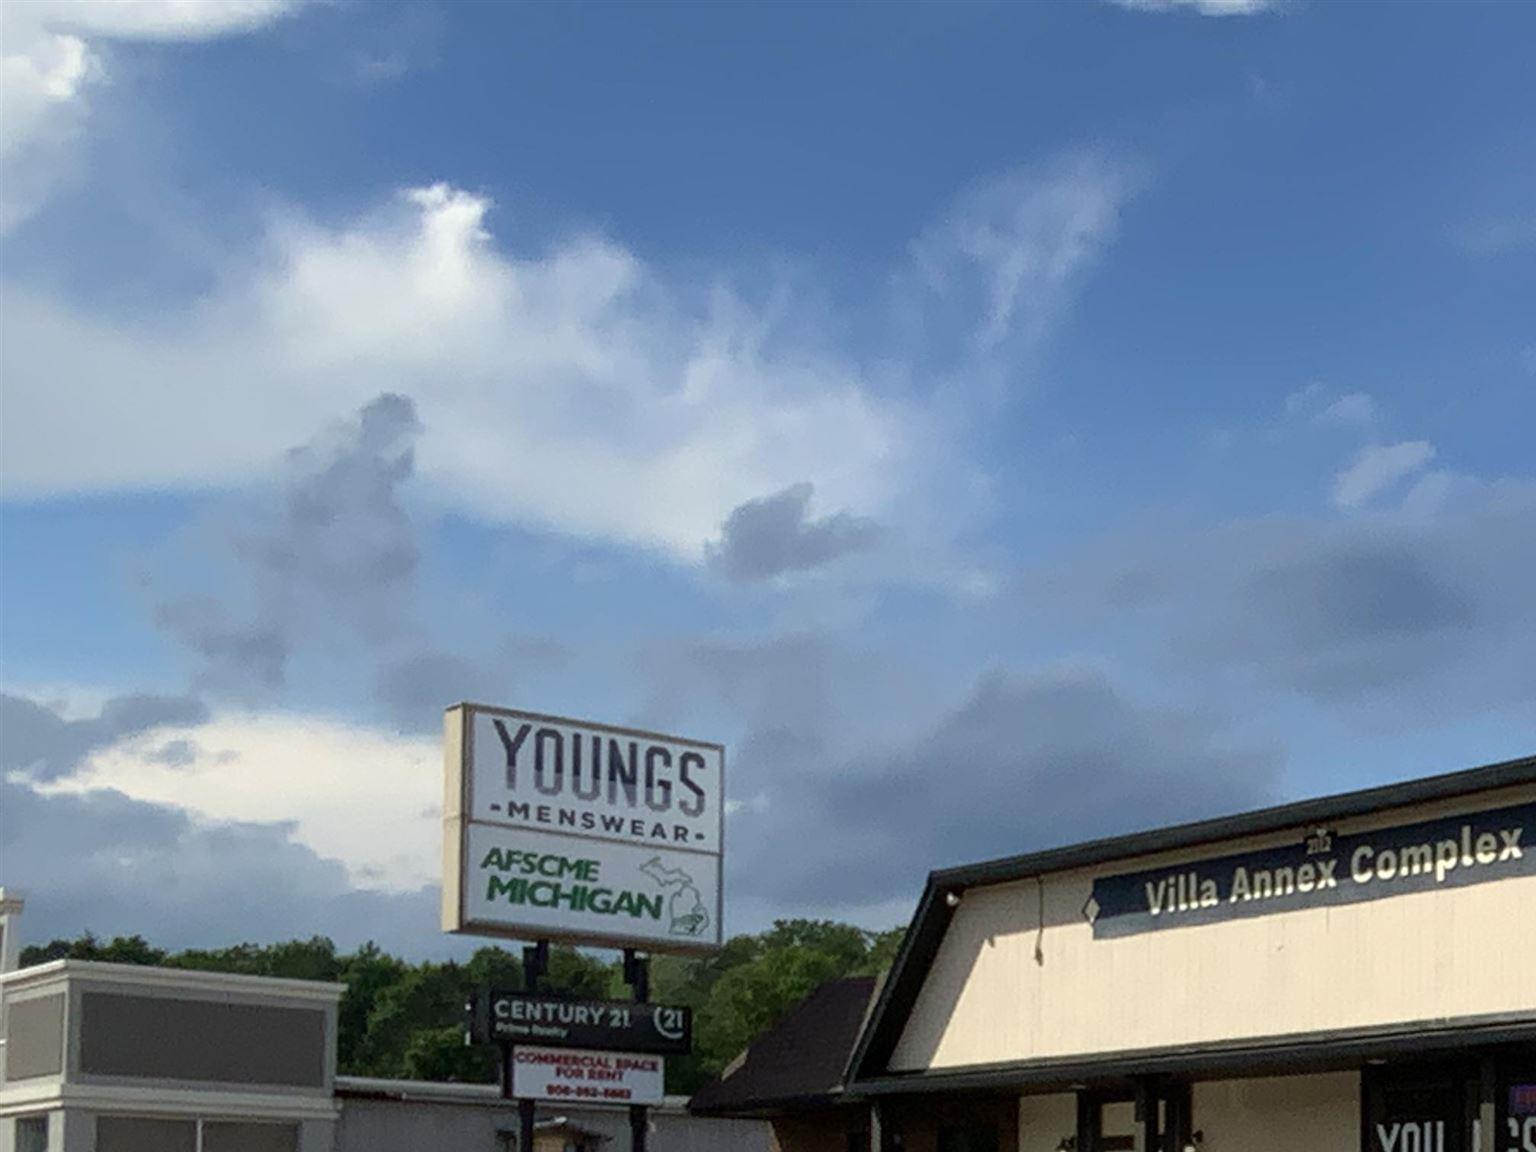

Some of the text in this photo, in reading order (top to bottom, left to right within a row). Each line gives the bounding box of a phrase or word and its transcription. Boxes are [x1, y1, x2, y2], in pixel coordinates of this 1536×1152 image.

[492, 718, 706, 818] YOUNGS
[480, 847, 601, 882] AFSCME
[1145, 825, 1524, 916] Villa Annex Complex
[486, 875, 664, 920] MICHIGAN
[494, 999, 631, 1028] CENTURY 21
[515, 1052, 659, 1071] COMMERCIAL SPACE
[555, 1066, 623, 1081] FOR RENT
